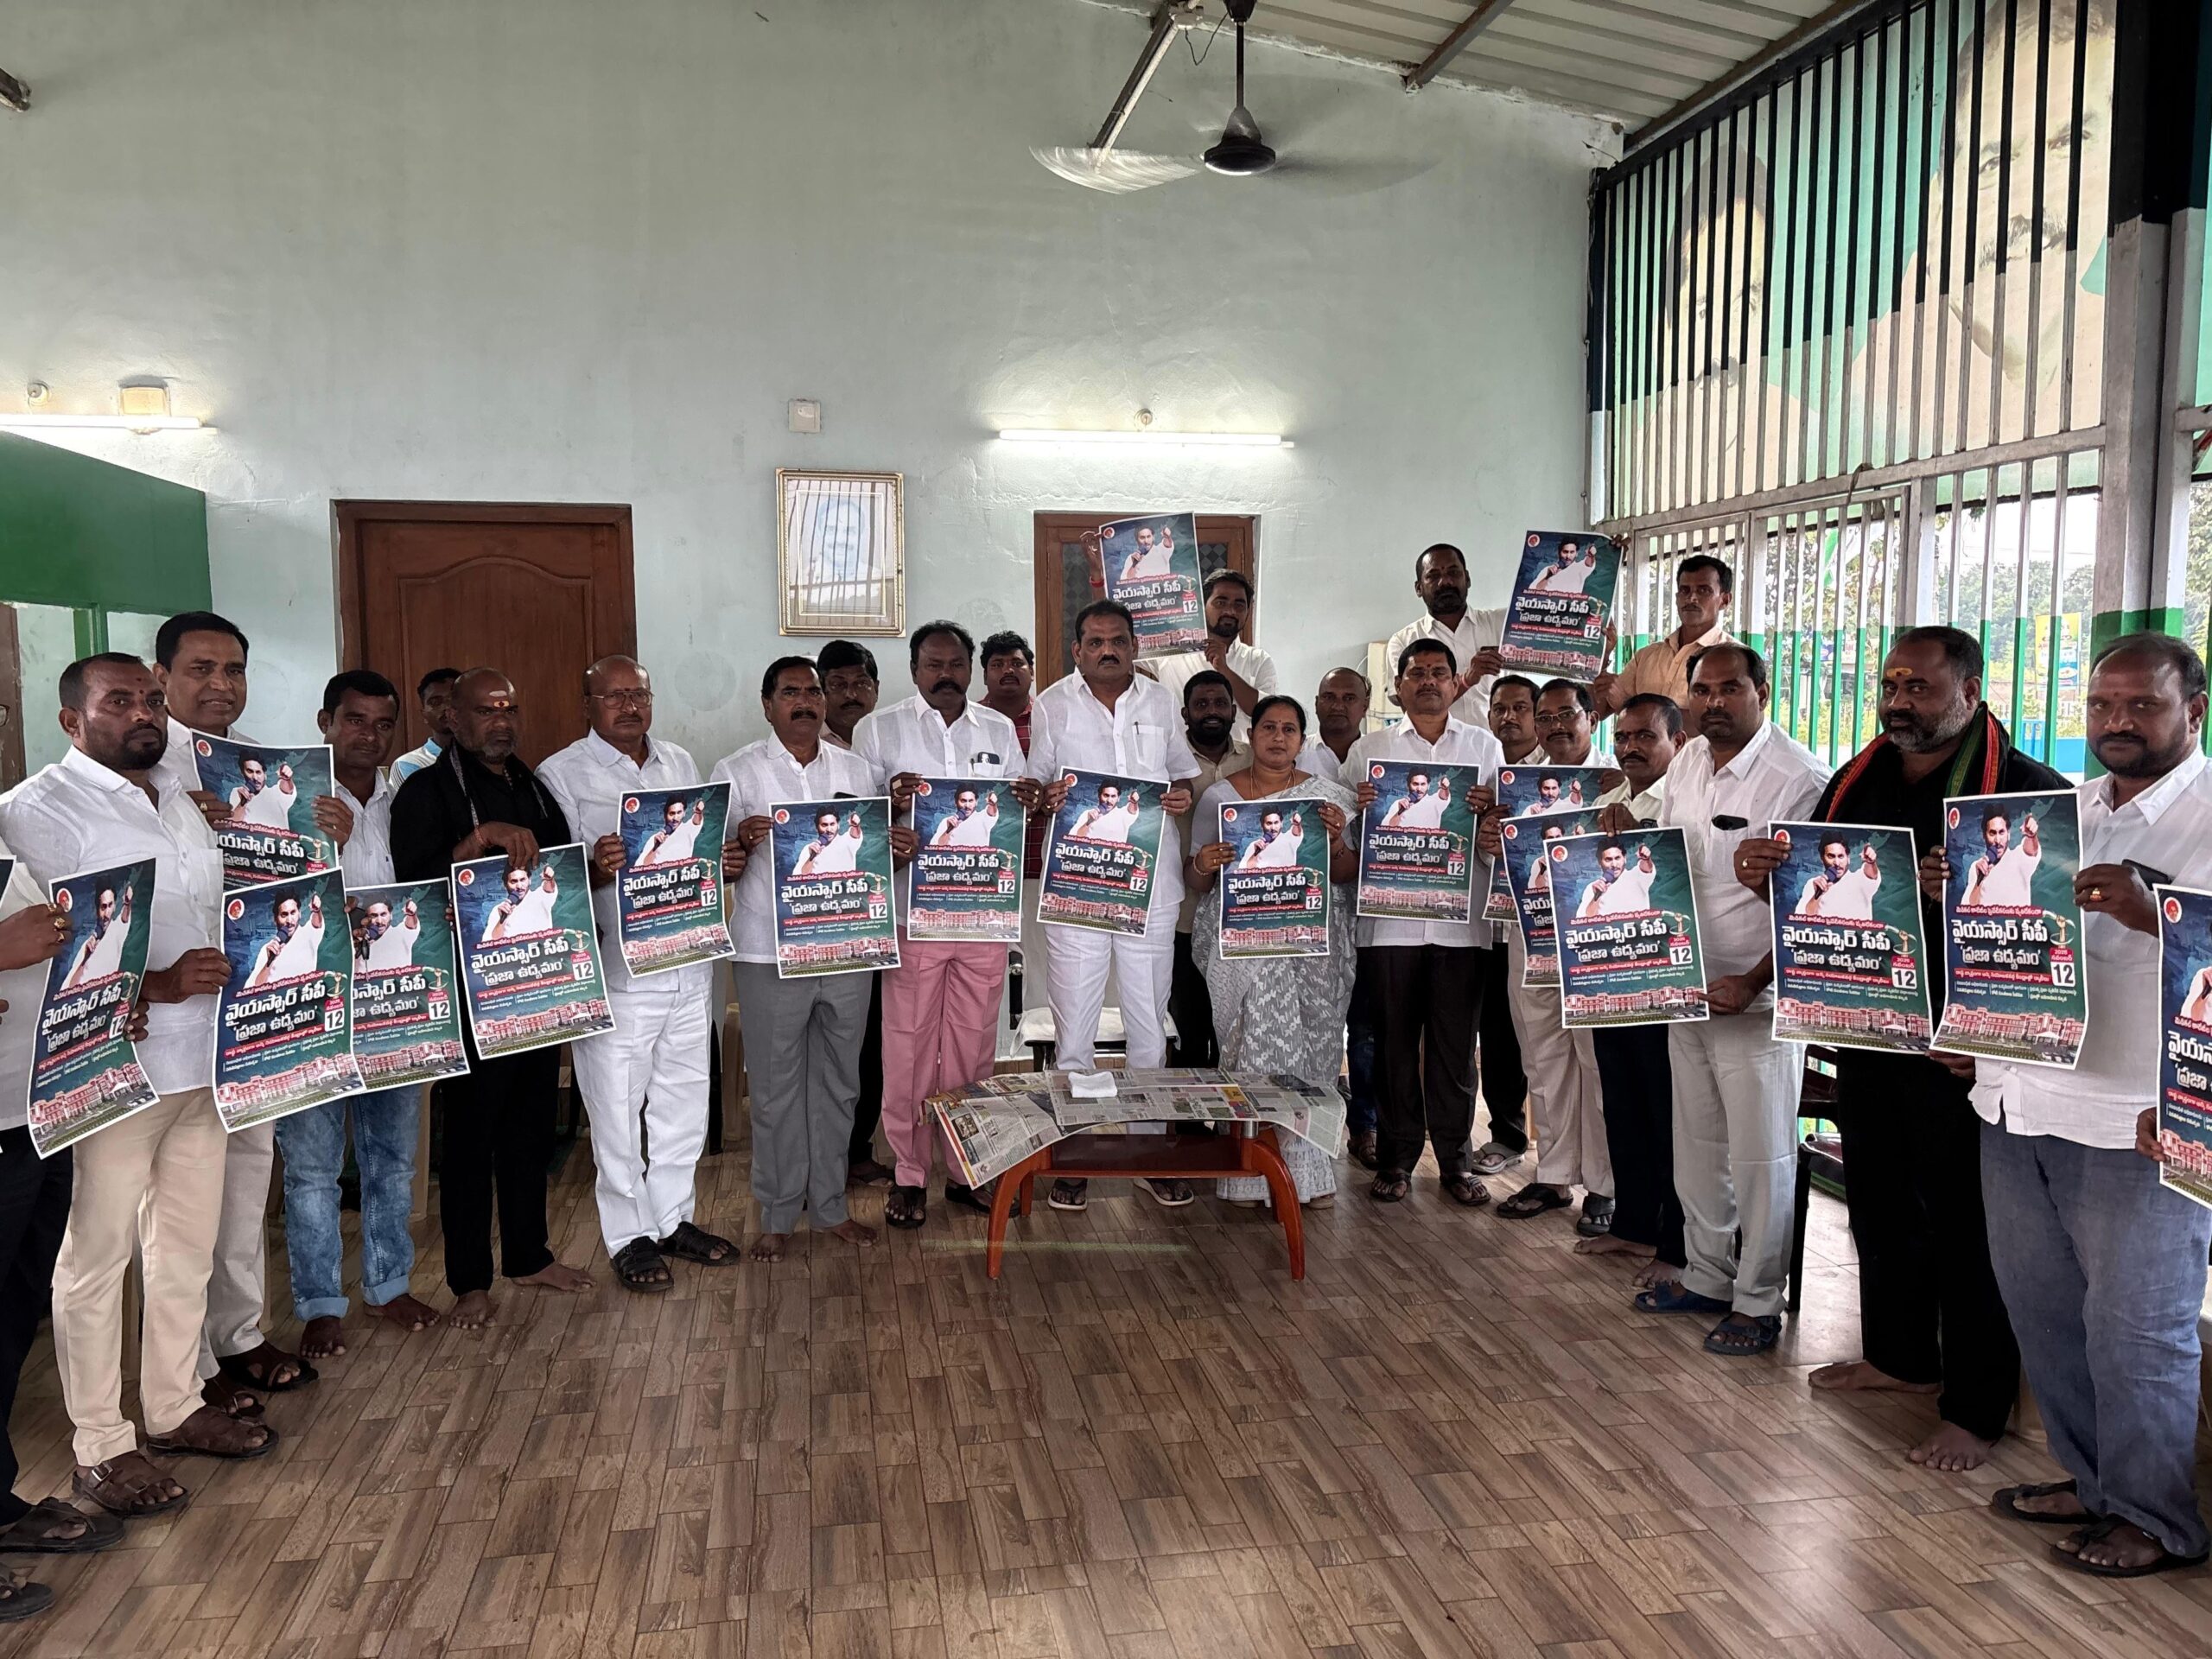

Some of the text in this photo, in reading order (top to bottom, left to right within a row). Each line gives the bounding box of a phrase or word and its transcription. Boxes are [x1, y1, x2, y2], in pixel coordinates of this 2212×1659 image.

[1163, 580, 1180, 593] సీపీ
[1185, 600, 1198, 613] 12
[1569, 601, 1588, 613] సీపీ
[1585, 626, 1602, 637] 12
[280, 840, 304, 857] సీపీ
[1429, 836, 1448, 849] సీపీ
[979, 854, 998, 868] సీపీ
[1056, 842, 1134, 865] వైయస్సార్ సీపీ
[253, 857, 298, 875] ఉద్యమం'
[1088, 865, 1126, 878] ఉద్యమం'
[1449, 862, 1466, 874] 12
[623, 868, 677, 896] వైయస్సార్
[680, 864, 699, 881] సీపీ
[999, 880, 1015, 893] 12
[1130, 878, 1148, 890] 12
[1229, 873, 1306, 893] వైయస్సార్ సీపీ
[658, 885, 694, 904] ఉద్యమం'
[702, 889, 716, 906] 12
[781, 879, 867, 902] వైయస్సార్ సీపీ
[1262, 890, 1300, 904] ఉద్యమం'
[820, 898, 861, 913] ఉద్యమం'
[871, 903, 887, 918] 12
[1306, 896, 1323, 909] 12
[1566, 922, 1637, 948] వైయస్సార్
[1640, 918, 1666, 936] సీపీ
[1783, 925, 1889, 950] వైయస్సార్ సీపీ
[1951, 919, 2047, 945] వైయస్సార్ సీపీ
[471, 937, 568, 973] వైయస్సార్ సీపీ
[1611, 941, 1659, 959] ఉద్యమం'
[1672, 946, 1691, 964] 12
[1993, 949, 2040, 969] ఉద్యమం'
[518, 958, 563, 979] ఉద్యమం'
[575, 961, 594, 980] 12
[1828, 954, 1881, 972] ఉద్యమం'
[400, 974, 426, 992] సీపీ
[1893, 969, 1916, 987] 12
[2053, 964, 2074, 984] 12
[42, 982, 122, 1035] వైయస్సార్ సీపీ
[226, 980, 325, 1027] వైయస్సార్ సీపీ
[370, 996, 419, 1017] ఉద్యమం'
[430, 1001, 449, 1020] 12
[73, 1010, 110, 1040] ఉద్యమం'
[111, 1016, 127, 1035] 12
[270, 1006, 318, 1031] ఉద్యమం'
[327, 1011, 342, 1028] 12
